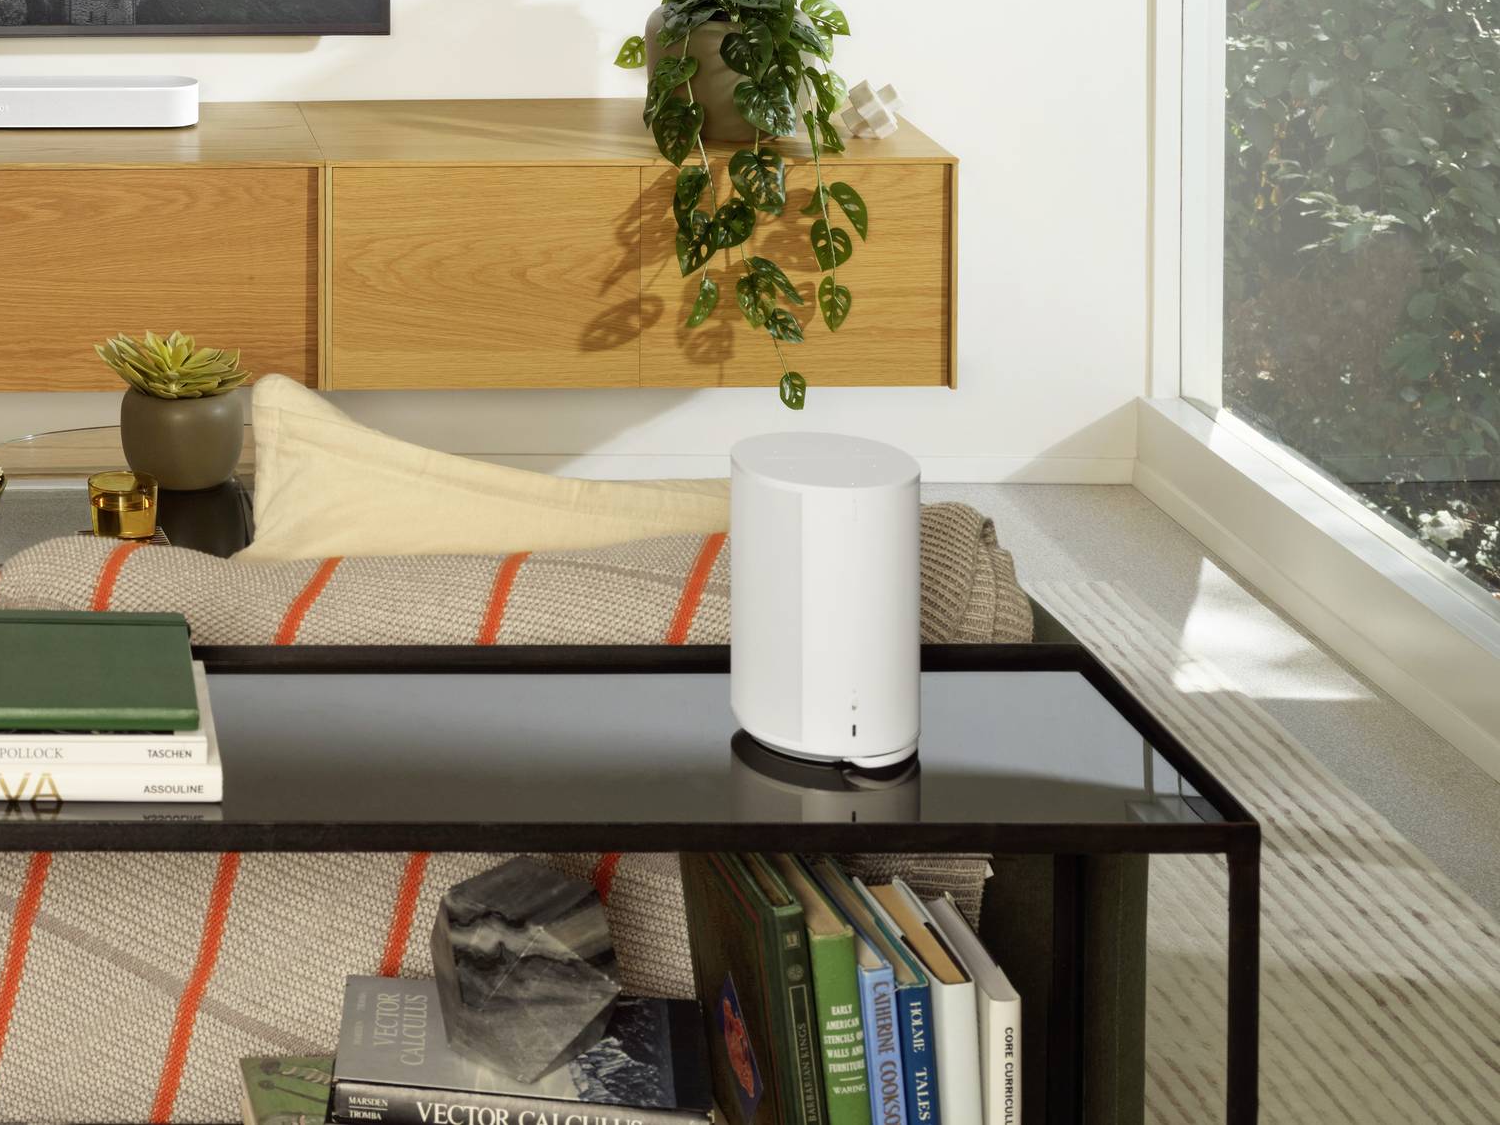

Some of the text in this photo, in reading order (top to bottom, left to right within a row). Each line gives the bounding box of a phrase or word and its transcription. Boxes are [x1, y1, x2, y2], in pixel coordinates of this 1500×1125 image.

[0, 747, 64, 759] POLLOCK
[148, 749, 192, 759] TASCHEN
[143, 785, 204, 794] ASSOULINE
[831, 1004, 853, 1015] EARLY
[373, 993, 400, 1046] VECTOR
[826, 1017, 860, 1030] AMERICAN
[873, 981, 895, 1055] CATHERINE
[401, 994, 428, 1066] CALCULUS
[824, 1033, 855, 1044] STENCILS
[1004, 1027, 1014, 1058] CORE
[826, 1048, 850, 1058] WALLS
[909, 1001, 931, 1121] HOLME TALES
[797, 1022, 818, 1122] BARBARIAN KINGS
[832, 1083, 867, 1094] WARING
[348, 1096, 389, 1107] MARSDEN
[348, 1109, 382, 1121] TROMBA
[416, 1101, 511, 1125] VECTOR
